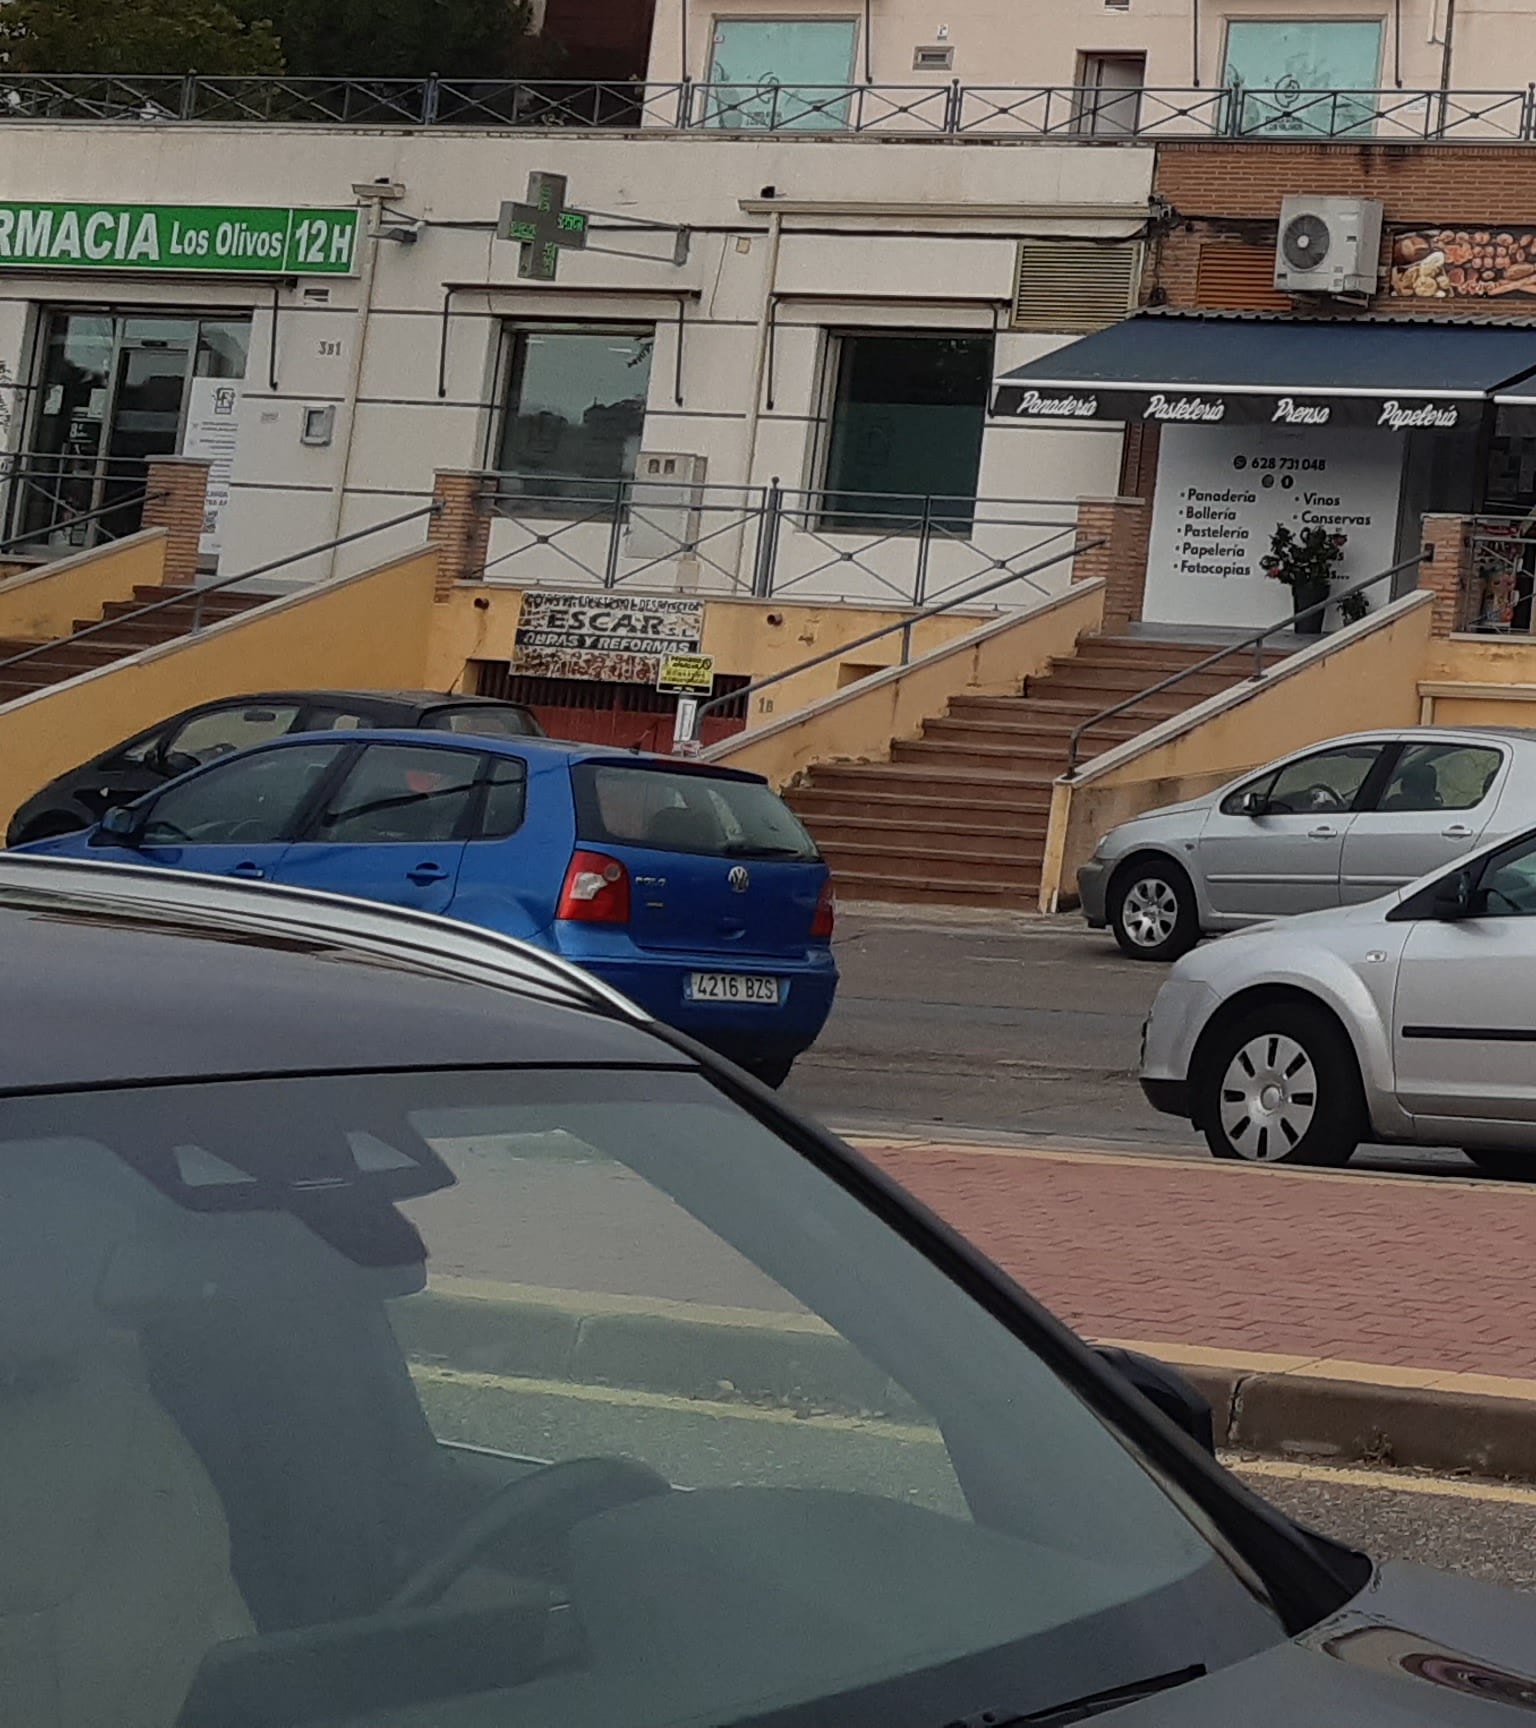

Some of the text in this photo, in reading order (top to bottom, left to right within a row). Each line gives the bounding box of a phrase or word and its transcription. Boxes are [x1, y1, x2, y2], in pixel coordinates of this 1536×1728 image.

[169, 220, 208, 255] Los
[215, 222, 282, 257] Olivos
[1016, 390, 1460, 432] Panadería Pastelería Prensa Papelería
[1251, 457, 1326, 471] 628 731 048
[1187, 488, 1256, 503] Panadería
[1303, 492, 1340, 506] Vinos
[1186, 506, 1236, 521] Bollería
[1301, 510, 1371, 526] Conservas
[1184, 524, 1249, 539] Pastelería
[1182, 542, 1245, 559] Papelería
[1180, 560, 1251, 578] Fotocopias
[548, 609, 663, 635] ESCAR
[584, 635, 594, 648] Y
[598, 637, 690, 654] REFORMAS
[758, 697, 774, 713] 1B
[697, 975, 774, 1000] 4216 BZS
